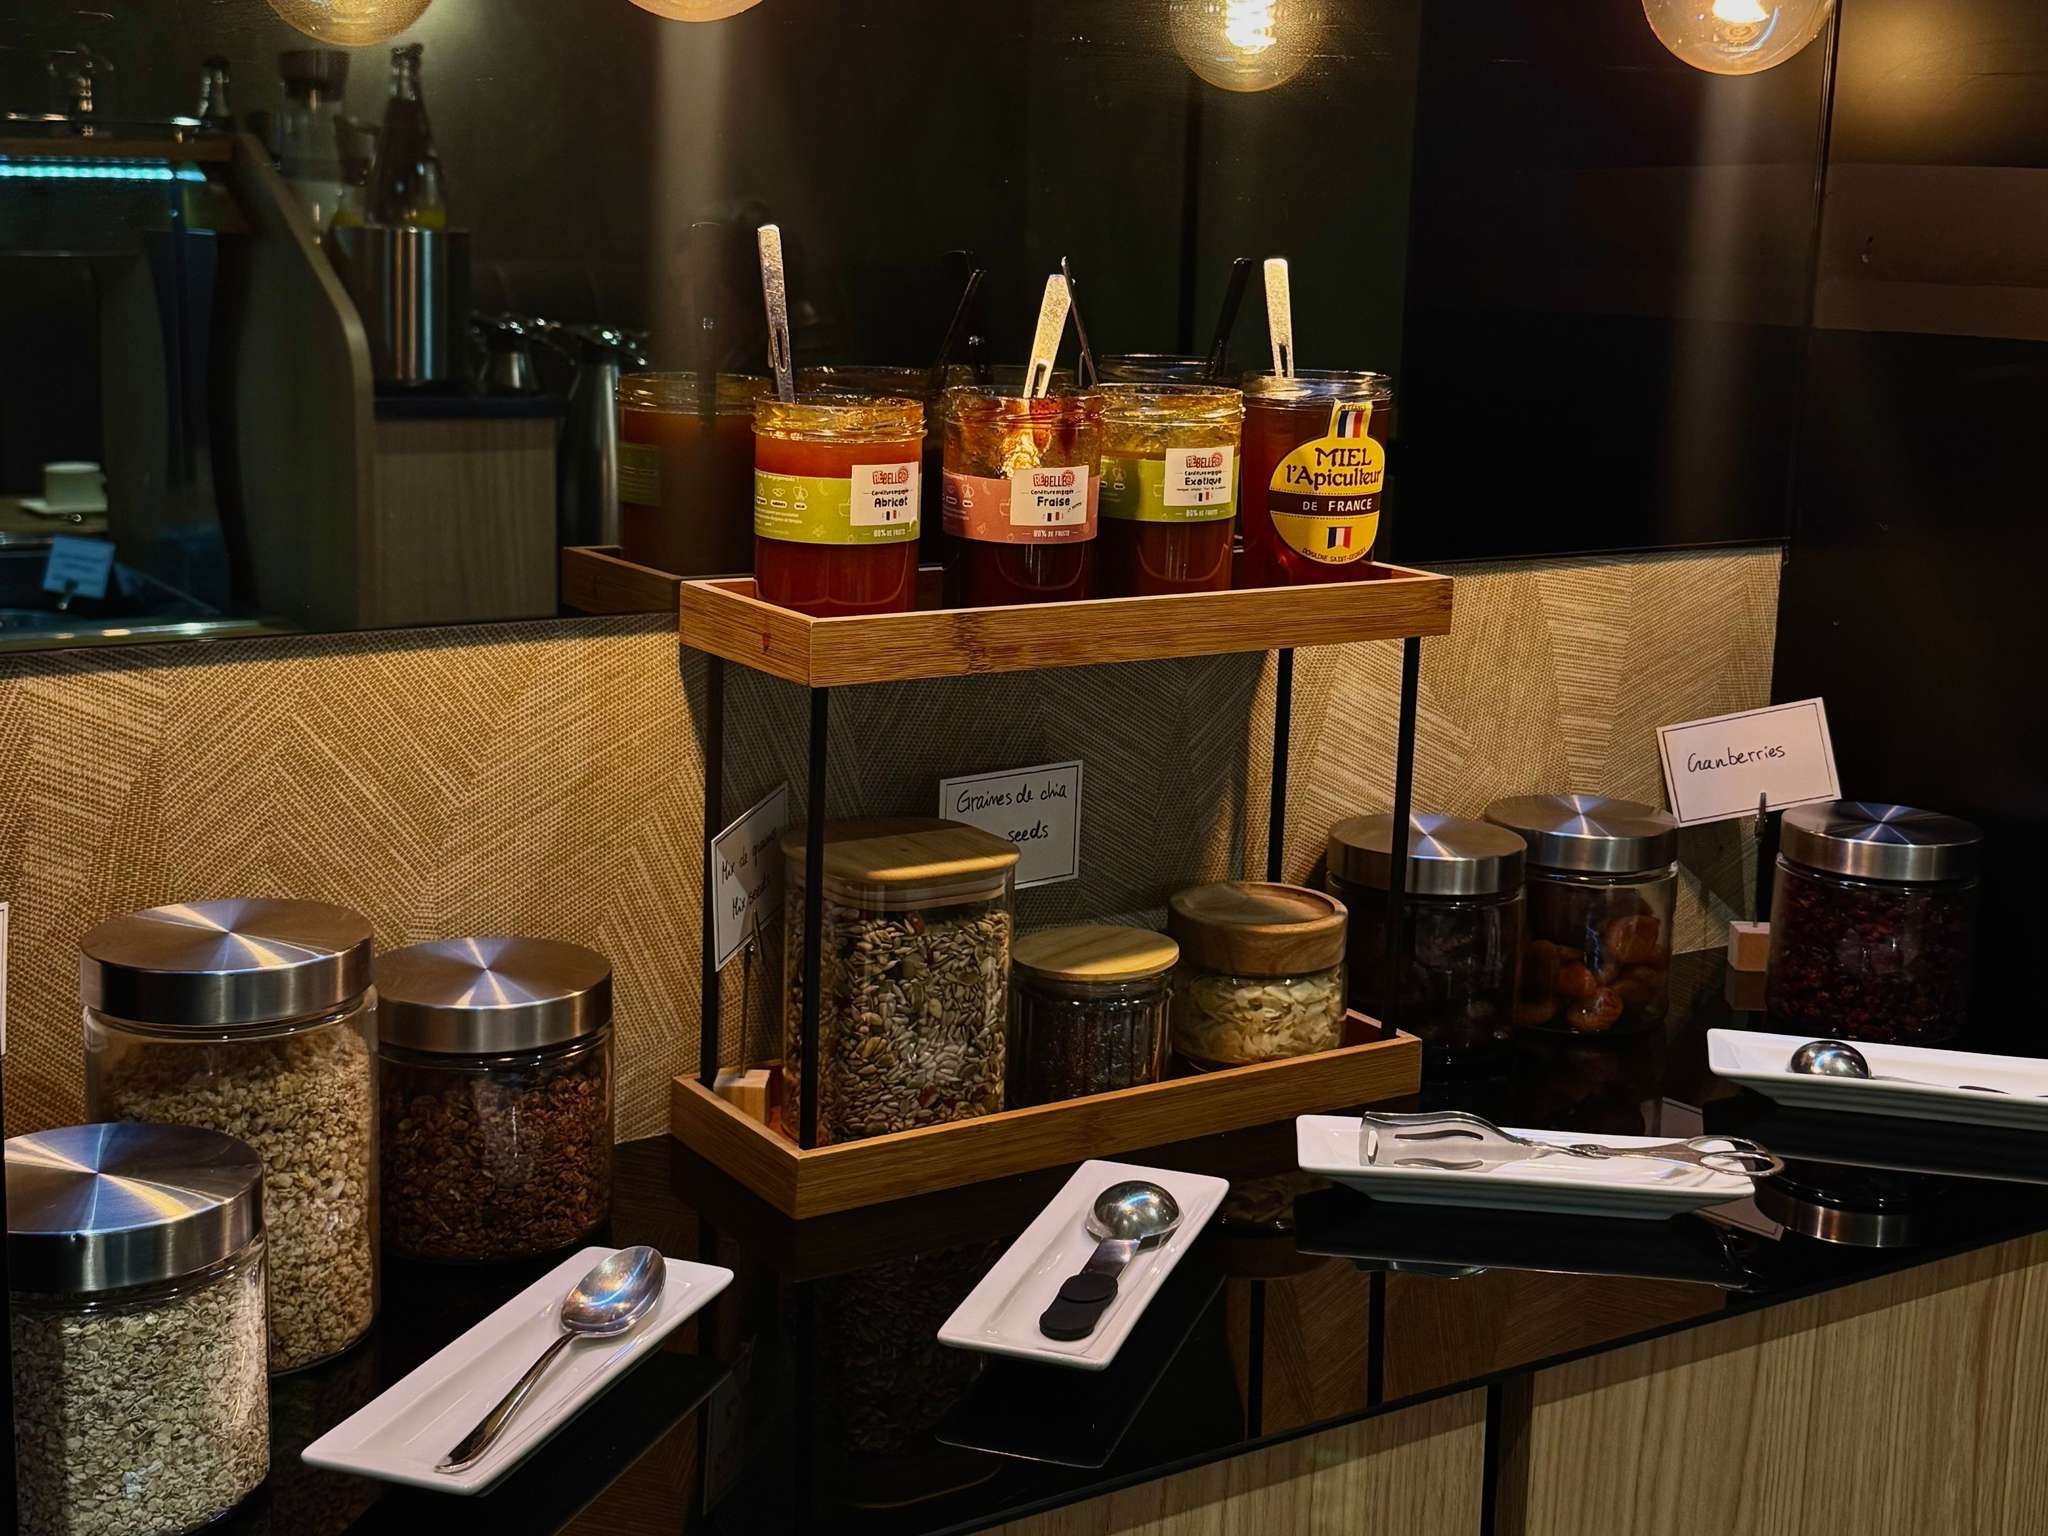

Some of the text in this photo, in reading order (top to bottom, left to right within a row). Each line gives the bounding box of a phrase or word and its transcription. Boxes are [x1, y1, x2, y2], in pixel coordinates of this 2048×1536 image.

[1315, 447, 1372, 467] MIEL
[1185, 476, 1222, 486] Exotique
[1286, 464, 1381, 491] l'Apiculteur
[874, 496, 908, 508] Abricot
[1037, 496, 1071, 507] Fraise
[1302, 498, 1372, 512] DE FRANCE
[1687, 746, 1786, 773] Cranberries
[956, 780, 1068, 813] Graines de chia
[1007, 820, 1049, 843] seeds
[721, 860, 735, 885] Mix
[732, 896, 746, 920] Mix
